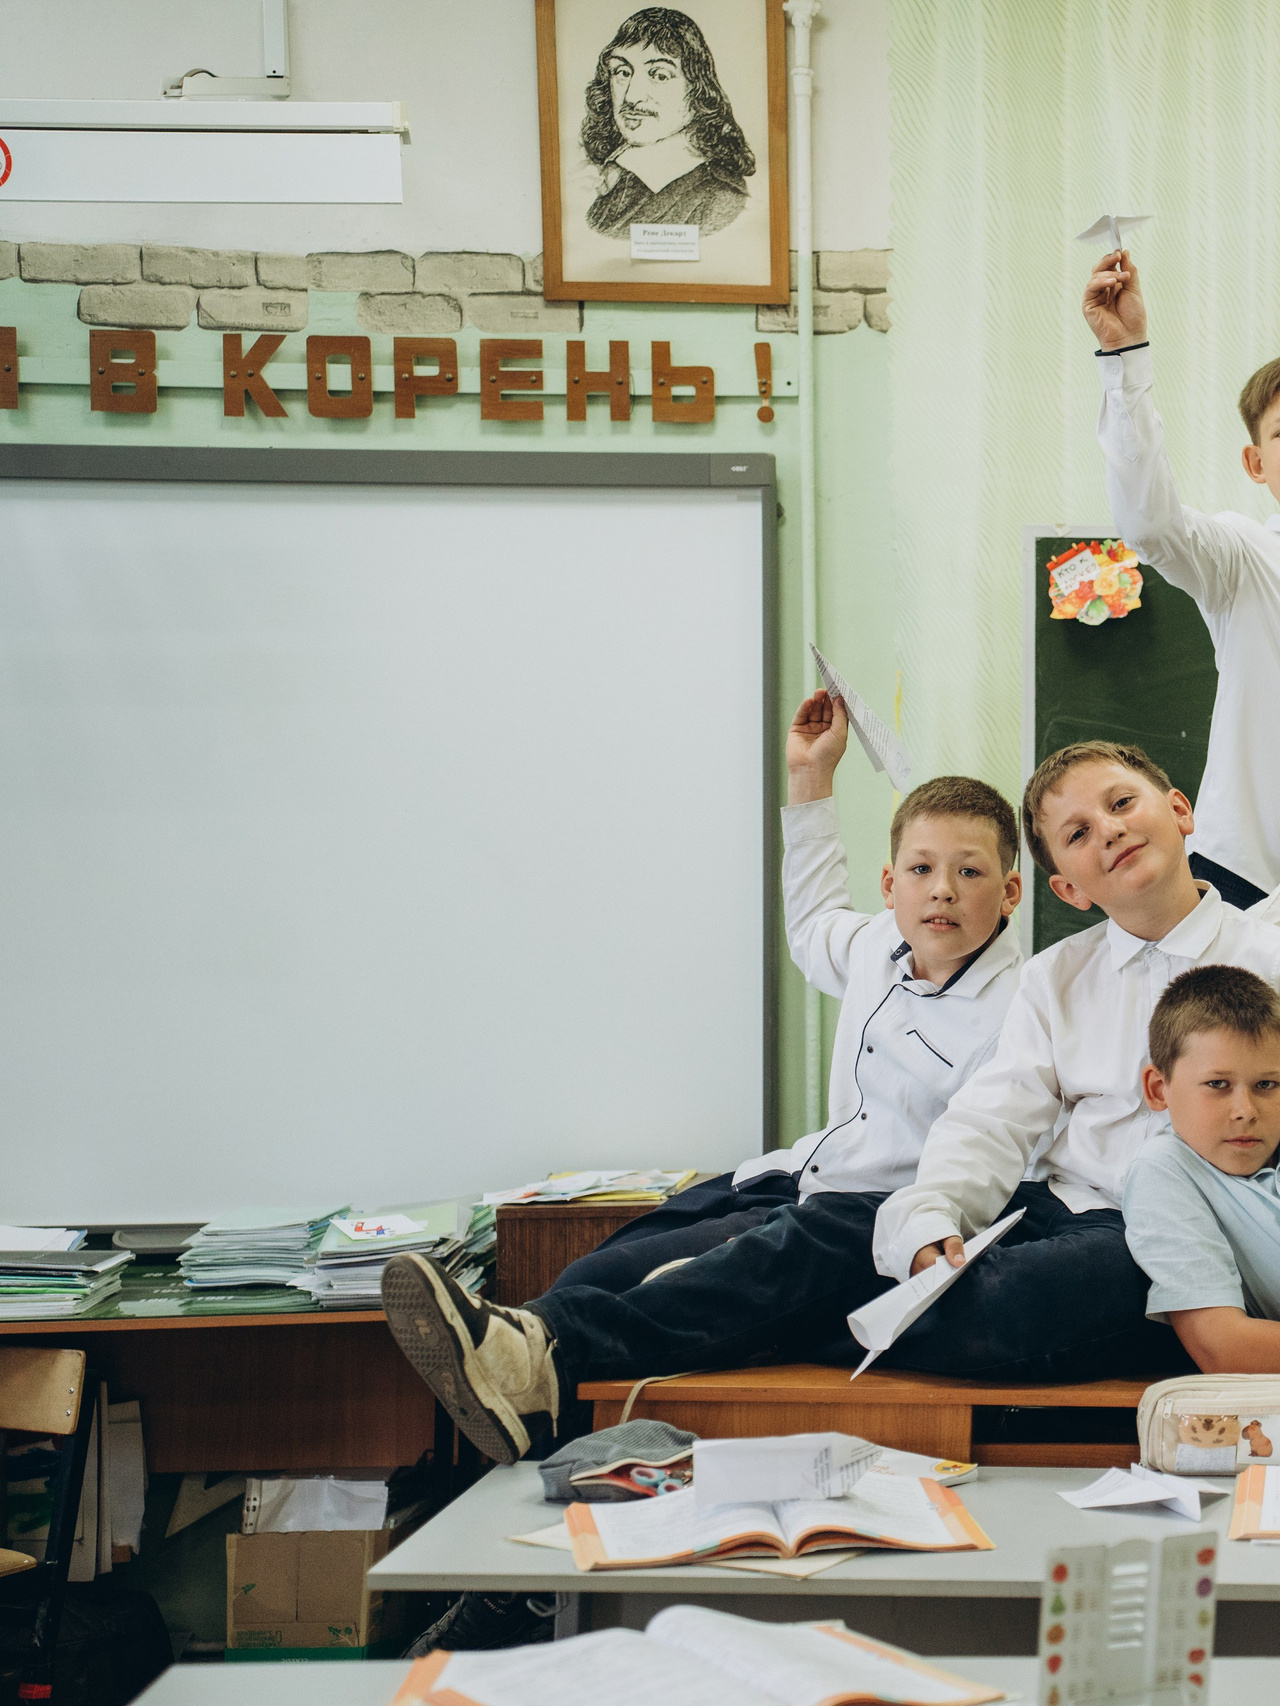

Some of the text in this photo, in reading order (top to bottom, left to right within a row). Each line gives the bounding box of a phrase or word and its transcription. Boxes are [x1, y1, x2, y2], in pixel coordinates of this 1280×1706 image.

[89, 329, 158, 413] В
[222, 333, 776, 424] КОРЕНЬ!
[1056, 563, 1077, 578] КТО
